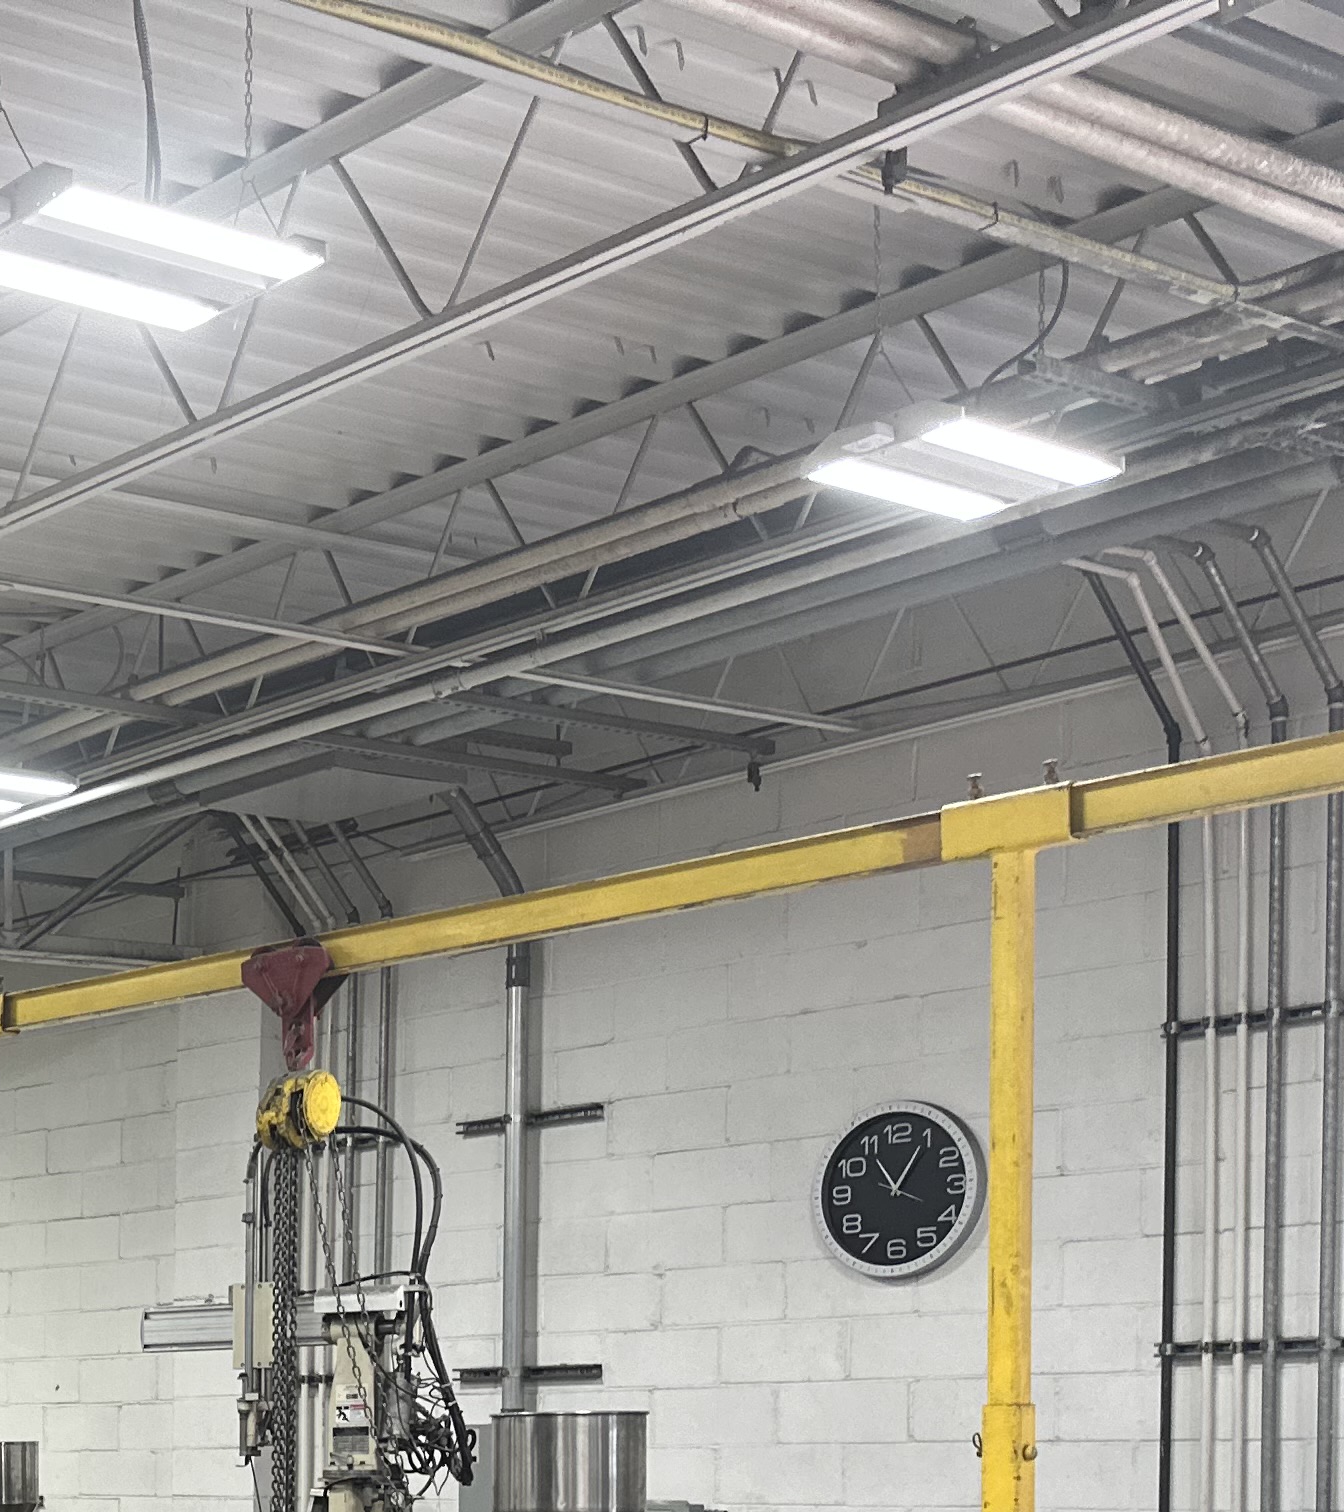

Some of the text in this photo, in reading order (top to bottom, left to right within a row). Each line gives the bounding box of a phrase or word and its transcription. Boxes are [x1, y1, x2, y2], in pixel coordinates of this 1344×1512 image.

[883, 1122, 912, 1145] 12
[922, 1127, 932, 1148] 1
[860, 1135, 879, 1156] 11
[837, 1156, 867, 1179] 10
[938, 1145, 960, 1169] 2
[946, 1173, 967, 1195] 3
[832, 1185, 852, 1206] 9
[842, 1213, 862, 1235] 8
[937, 1204, 957, 1224] 4
[858, 1232, 880, 1254] 7
[916, 1226, 937, 1248] 5
[886, 1238, 907, 1260] 6
